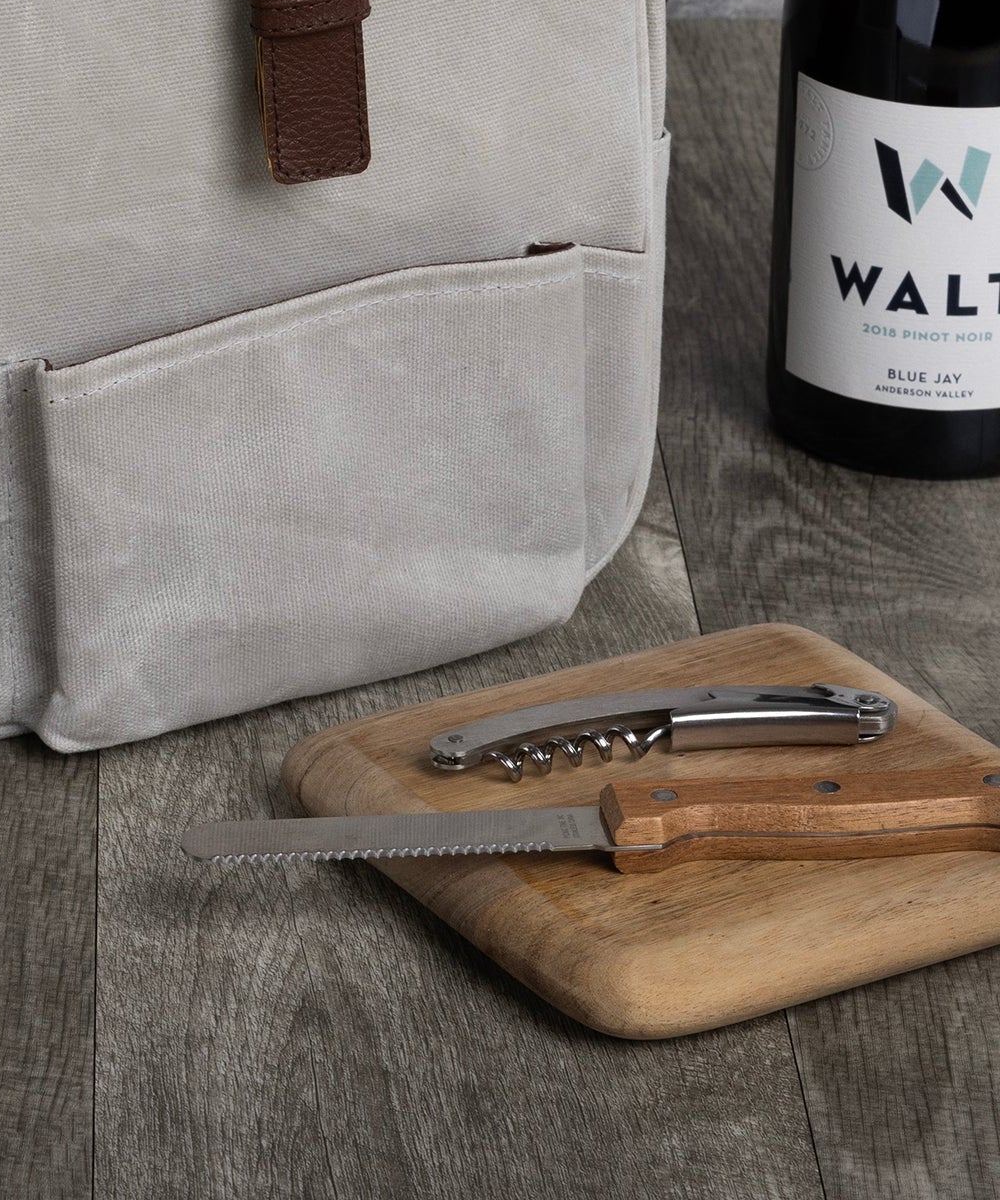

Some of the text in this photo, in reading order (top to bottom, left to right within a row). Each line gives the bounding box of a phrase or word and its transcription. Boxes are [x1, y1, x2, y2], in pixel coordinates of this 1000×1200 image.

[861, 322, 993, 343] 2018 PINOT NOIR
[887, 368, 963, 385] BLUE JAY
[875, 384, 975, 399] ANDERSON VALLEY
